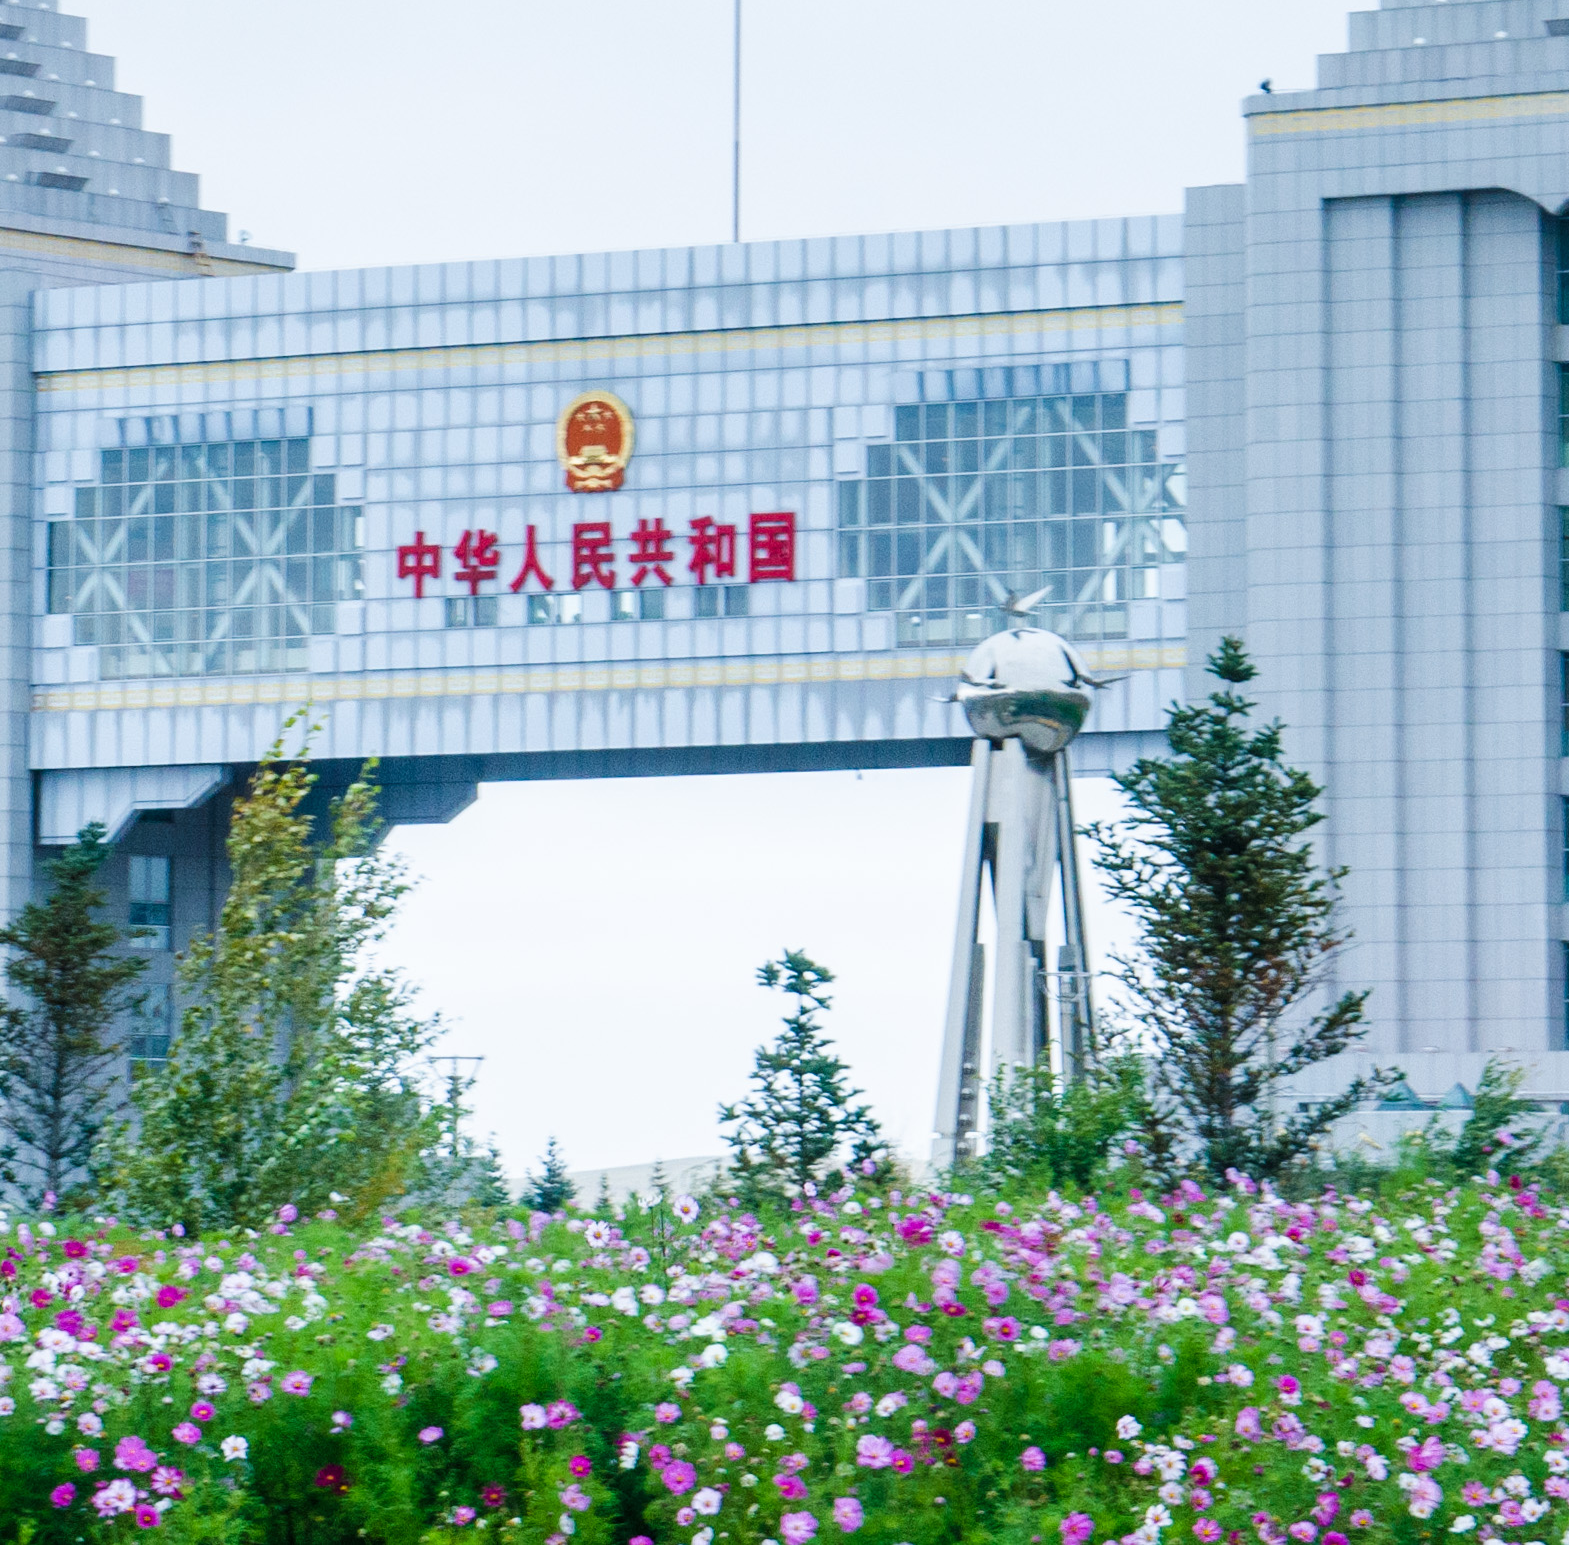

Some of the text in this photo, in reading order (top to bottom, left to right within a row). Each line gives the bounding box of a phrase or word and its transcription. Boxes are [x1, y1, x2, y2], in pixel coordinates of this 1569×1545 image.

[397, 511, 796, 599] 中华人民共和国
